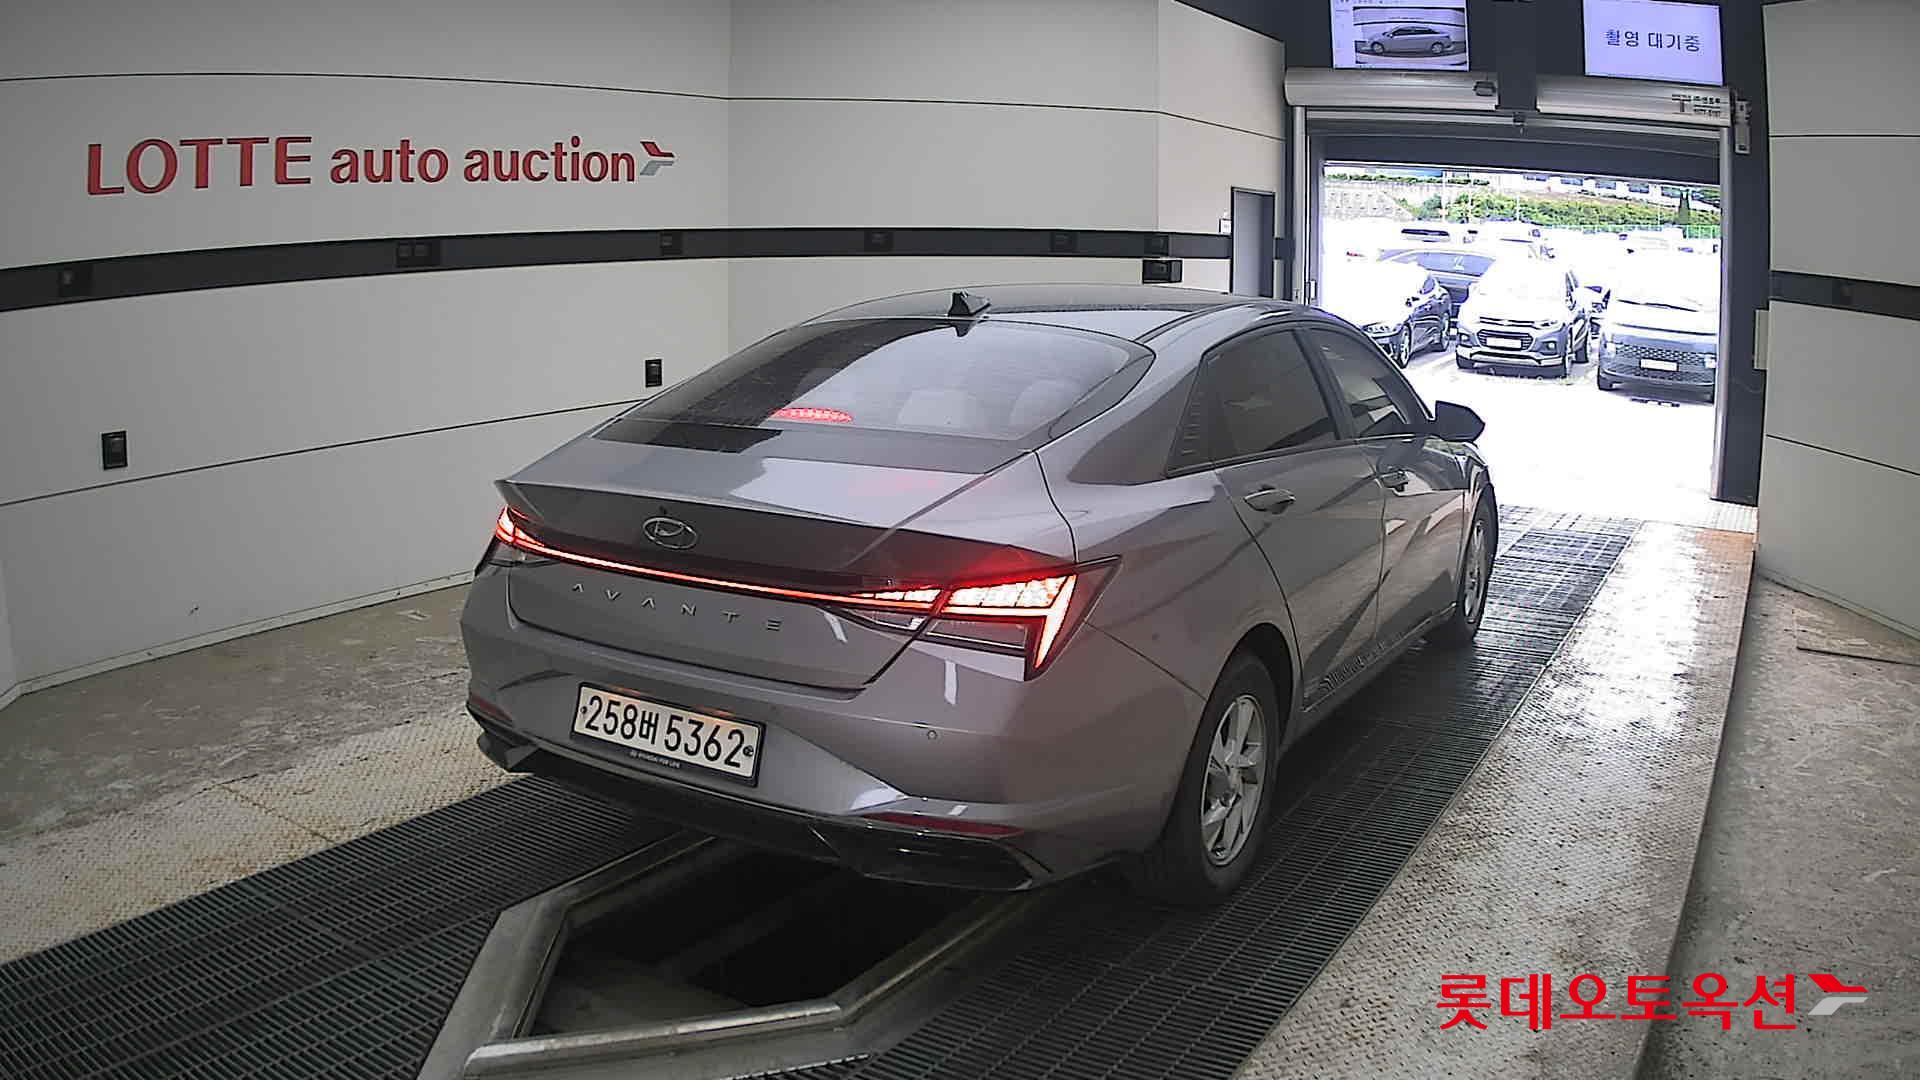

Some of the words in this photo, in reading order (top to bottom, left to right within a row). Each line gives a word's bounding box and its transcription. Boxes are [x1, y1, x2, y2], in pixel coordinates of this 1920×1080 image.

[1647, 32, 1700, 52] 대기중
[87, 136, 312, 195] LOTTE
[329, 139, 449, 183] auto
[463, 135, 636, 183] auction
[571, 582, 783, 633] AVANTE
[585, 695, 660, 746] 258버
[664, 713, 746, 768] 5362
